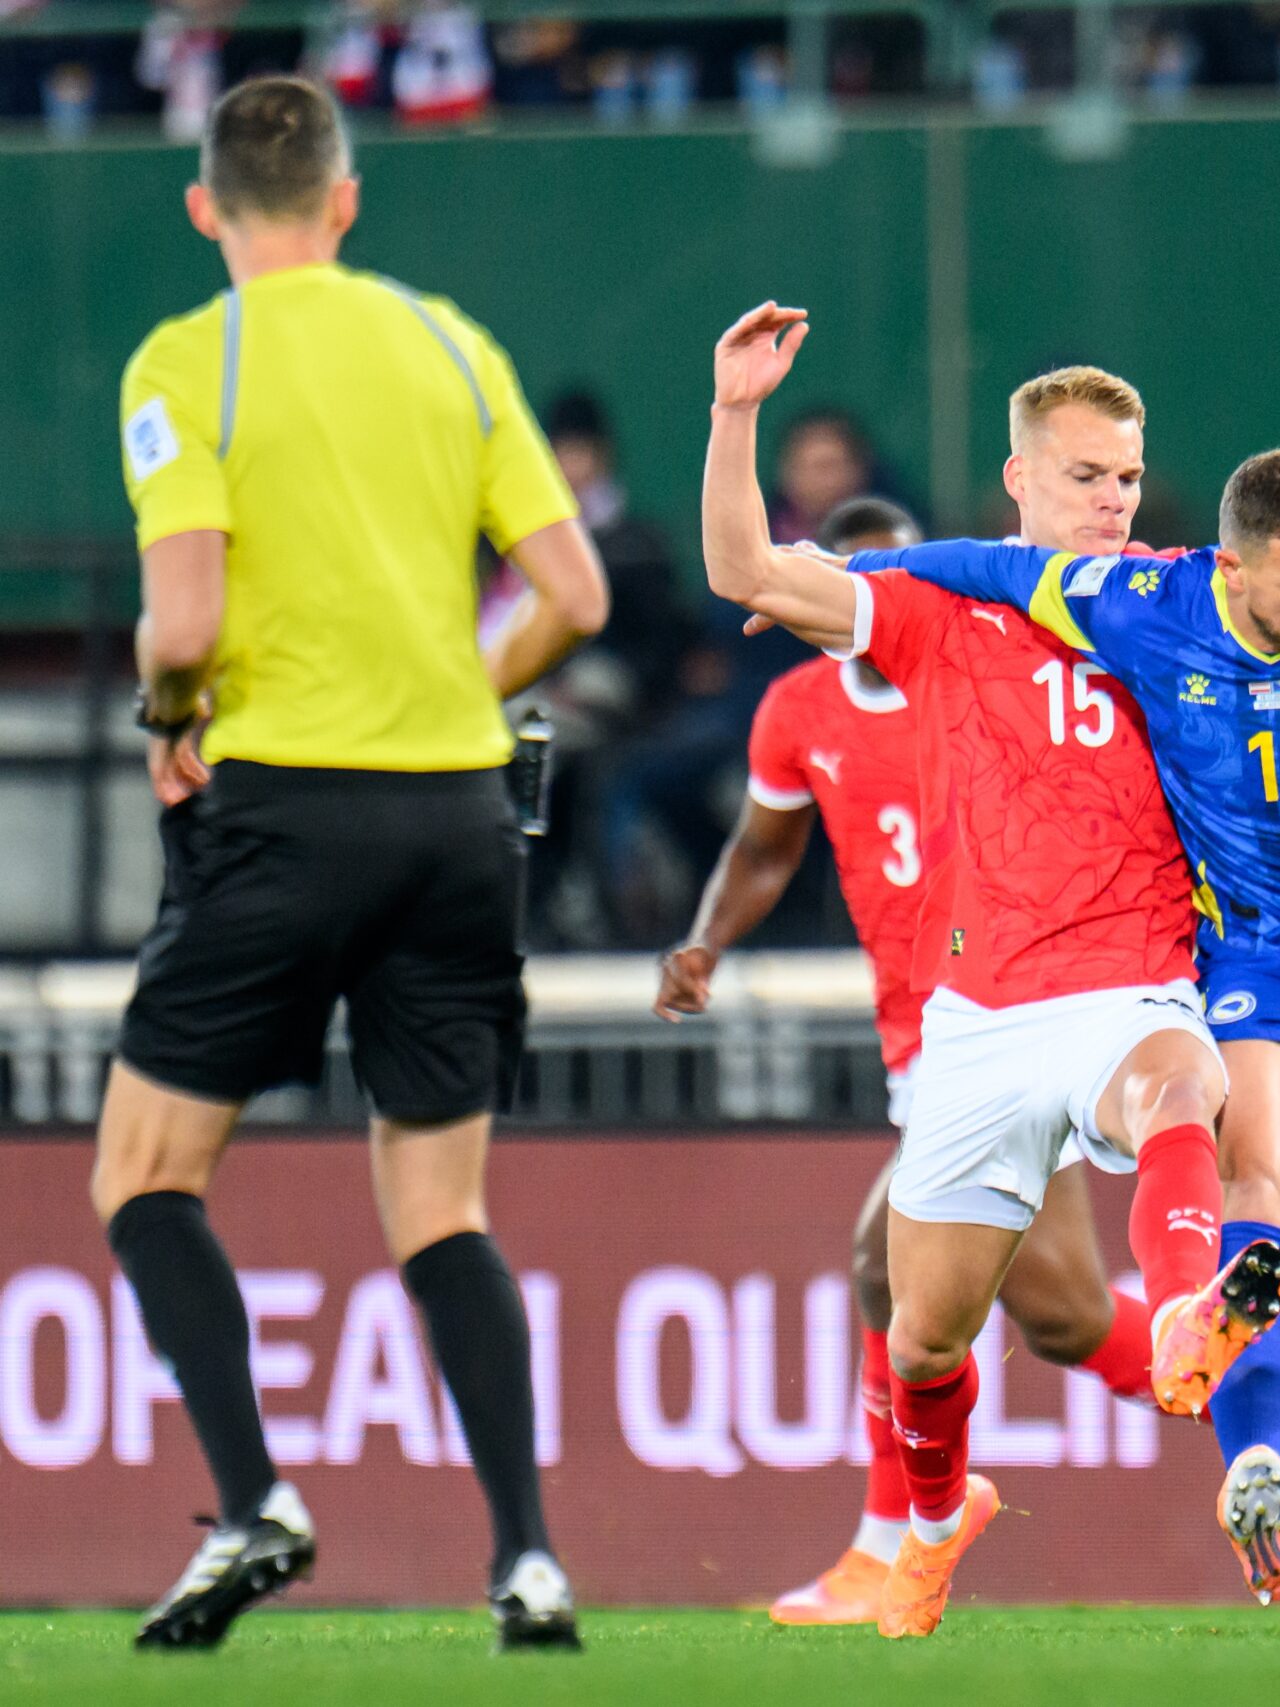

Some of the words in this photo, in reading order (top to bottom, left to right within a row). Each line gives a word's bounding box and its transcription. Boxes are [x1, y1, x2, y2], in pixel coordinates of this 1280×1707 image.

[1032, 659, 1115, 748] 15
[1179, 692, 1217, 706] KELME
[876, 804, 922, 888] 3
